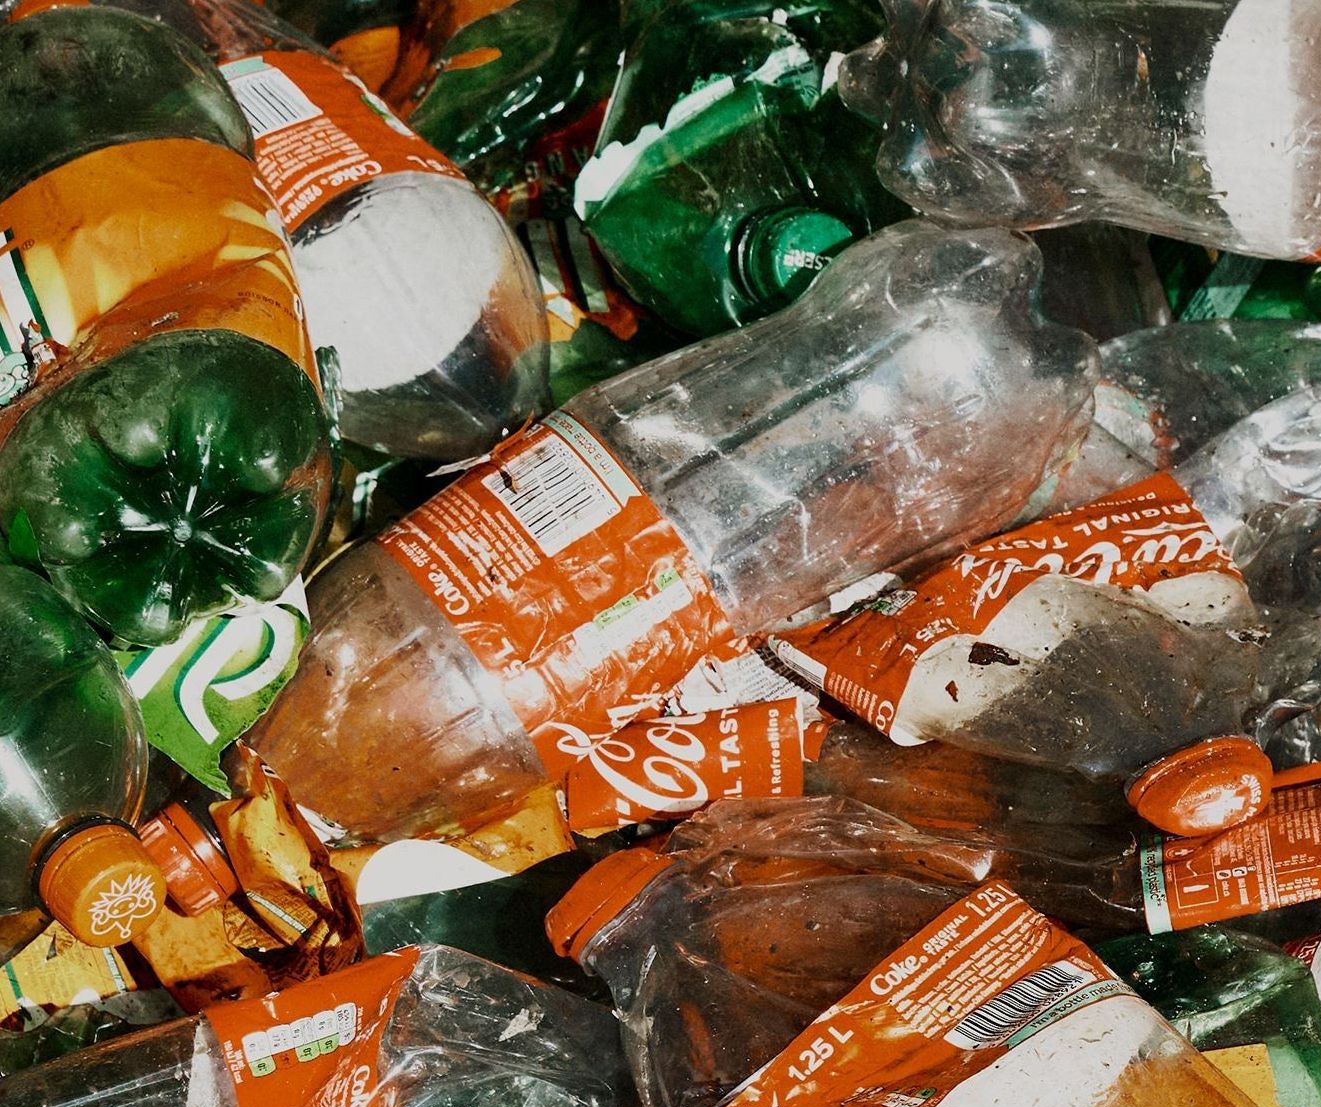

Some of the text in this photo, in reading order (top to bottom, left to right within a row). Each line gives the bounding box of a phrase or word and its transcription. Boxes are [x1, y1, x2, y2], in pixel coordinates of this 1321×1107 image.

[326, 155, 383, 191] Coke
[423, 562, 473, 619] Coke
[764, 706, 784, 783] Refreshing
[921, 881, 1006, 953] ORIGINAL 1.25
[927, 929, 959, 958] TASTE
[865, 948, 922, 1001] Coke
[1030, 1015, 1046, 1030] I'm
[1045, 1012, 1054, 1021] a
[1053, 988, 1091, 1021] bottle
[784, 1020, 853, 1088] 1.25 L
